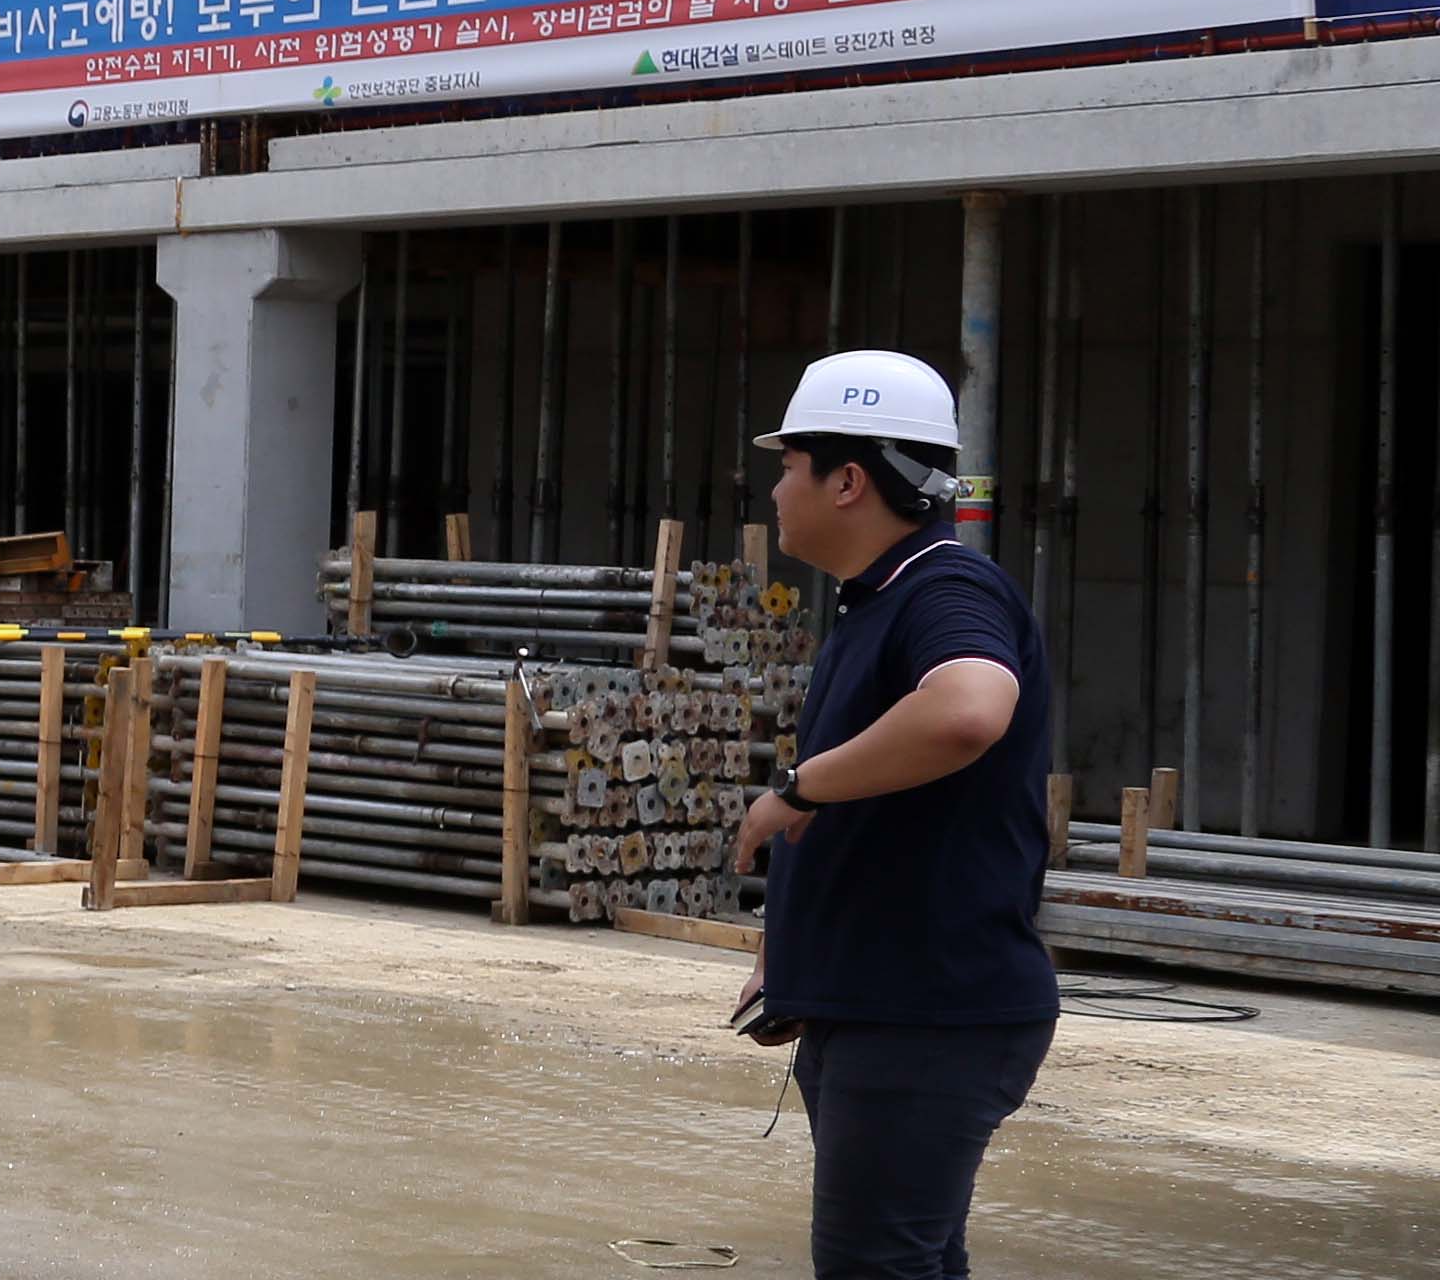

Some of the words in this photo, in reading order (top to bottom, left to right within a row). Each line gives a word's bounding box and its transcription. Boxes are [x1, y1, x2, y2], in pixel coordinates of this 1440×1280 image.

[86, 49, 162, 82] 안전수칙
[172, 44, 242, 73] 지키기,
[255, 37, 301, 64] 사전
[315, 23, 443, 60] 위험성평가
[455, 15, 516, 46] 실시,
[661, 43, 739, 72] 현대건설
[745, 36, 828, 63] 힐스테이트
[833, 30, 895, 56] 당진2차
[901, 25, 936, 47] 현장
[348, 78, 420, 100] 안전보건공단
[93, 102, 143, 121] 고용노동부
[842, 387, 881, 406] PD
